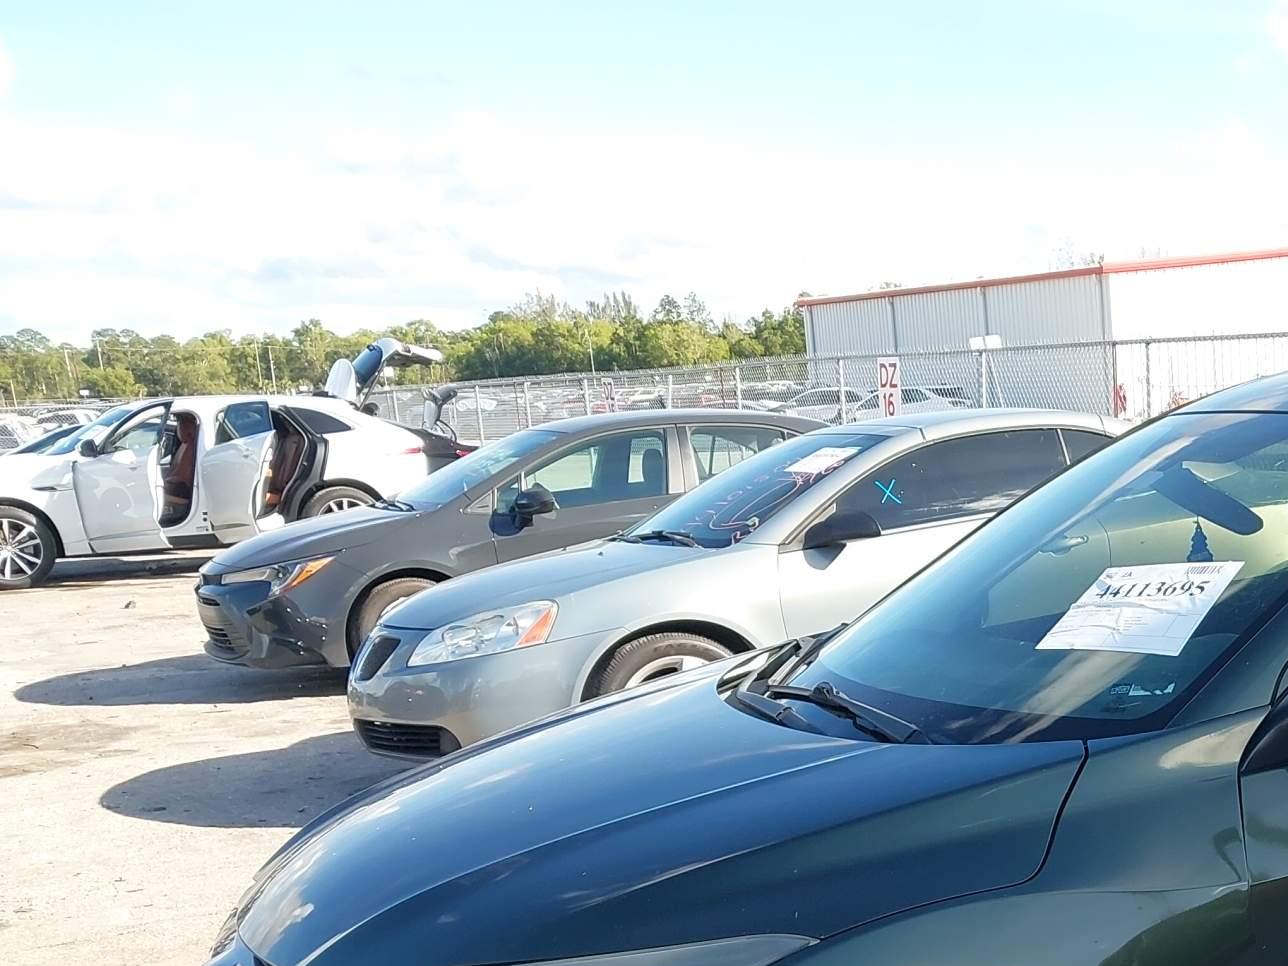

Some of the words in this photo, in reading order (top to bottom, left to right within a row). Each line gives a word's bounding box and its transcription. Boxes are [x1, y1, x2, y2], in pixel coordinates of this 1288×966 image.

[879, 362, 898, 388] DZ
[882, 392, 896, 417] 16
[1096, 579, 1210, 599] 44113695
